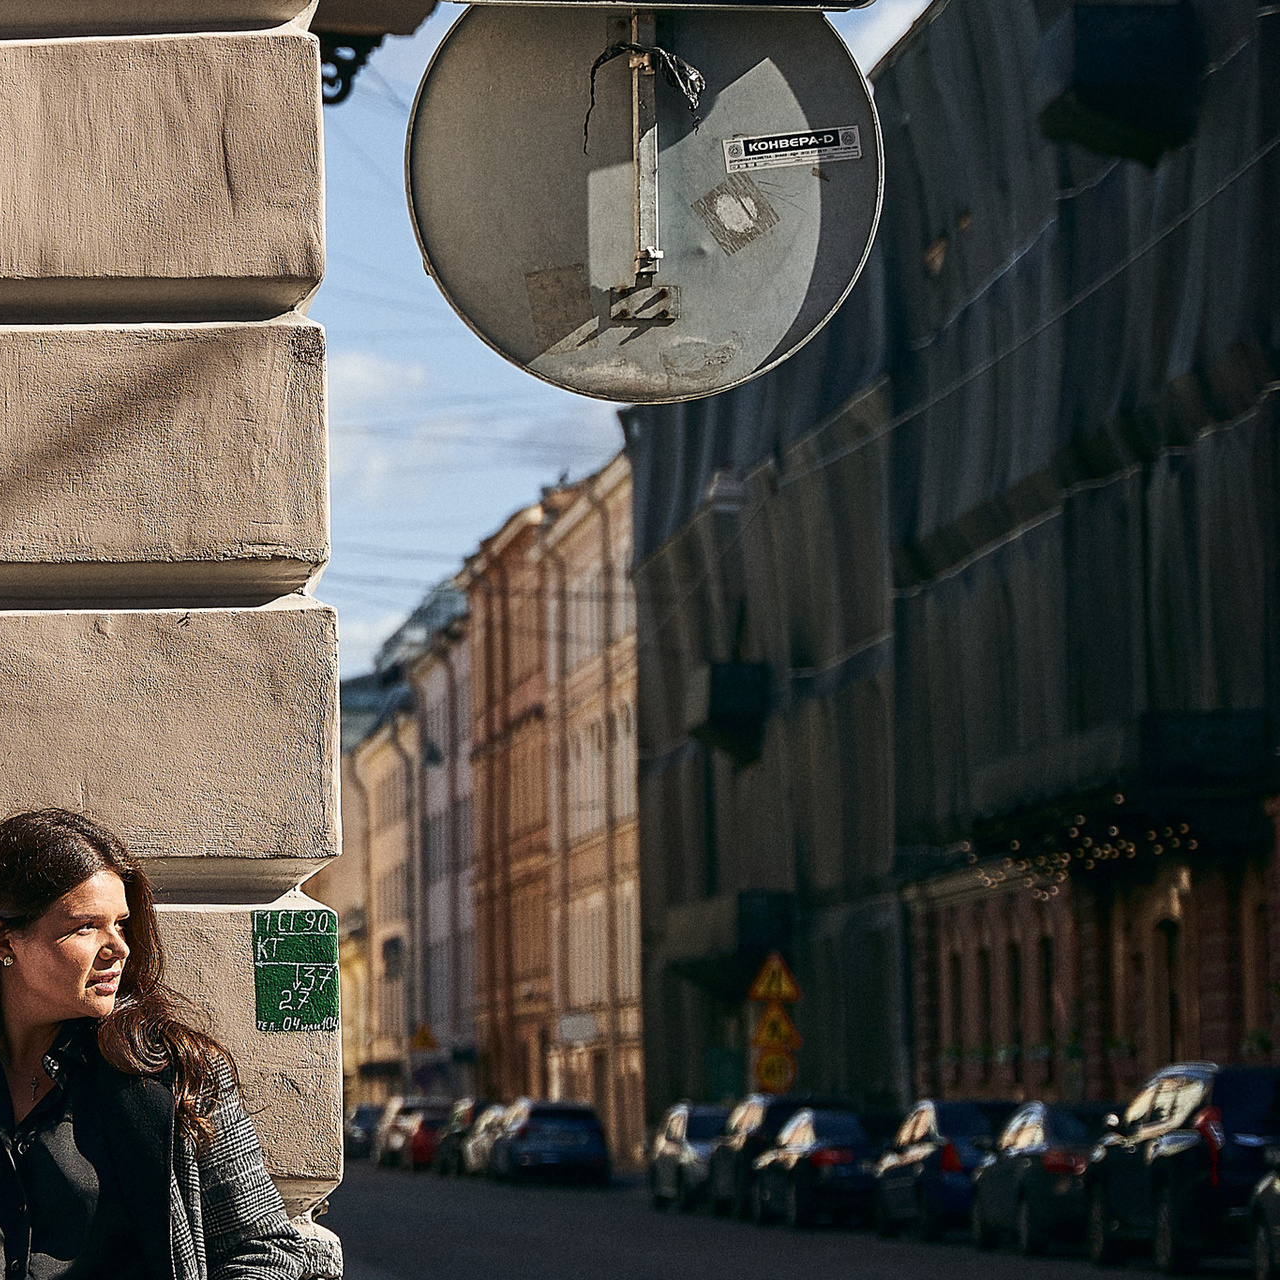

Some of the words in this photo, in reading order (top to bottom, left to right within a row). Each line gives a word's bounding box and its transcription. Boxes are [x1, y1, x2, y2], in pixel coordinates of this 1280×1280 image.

[303, 910, 329, 932] 90
[257, 935, 285, 960] КТ
[278, 990, 310, 1010] 2.7
[282, 1016, 301, 1031] 04
